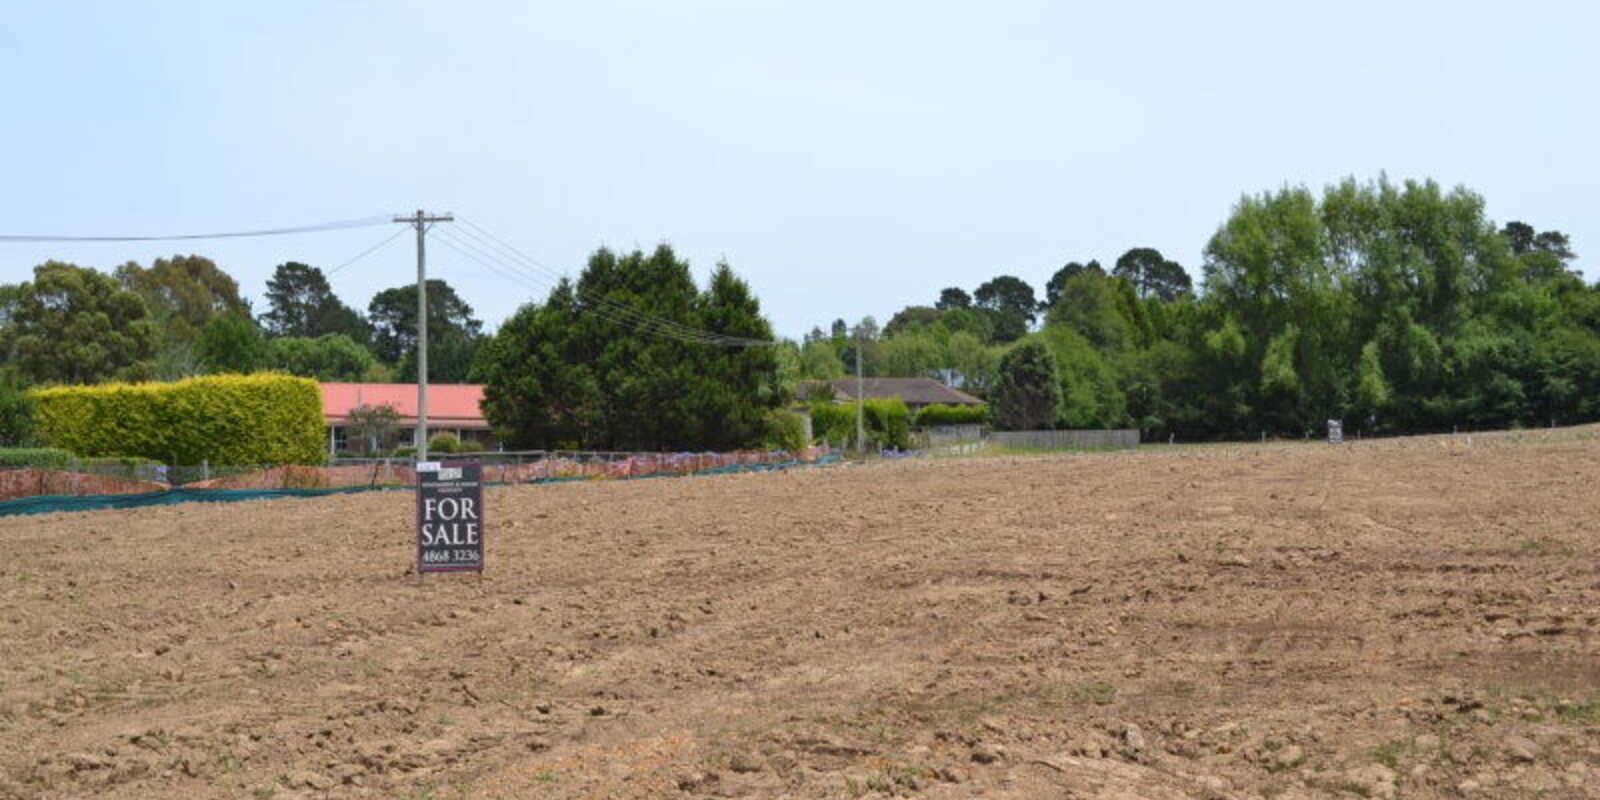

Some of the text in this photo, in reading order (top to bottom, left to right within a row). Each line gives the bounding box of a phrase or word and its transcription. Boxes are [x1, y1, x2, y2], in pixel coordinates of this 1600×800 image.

[424, 498, 478, 521] FOR
[422, 523, 479, 545] SALE
[423, 550, 479, 562] 4868 3236
